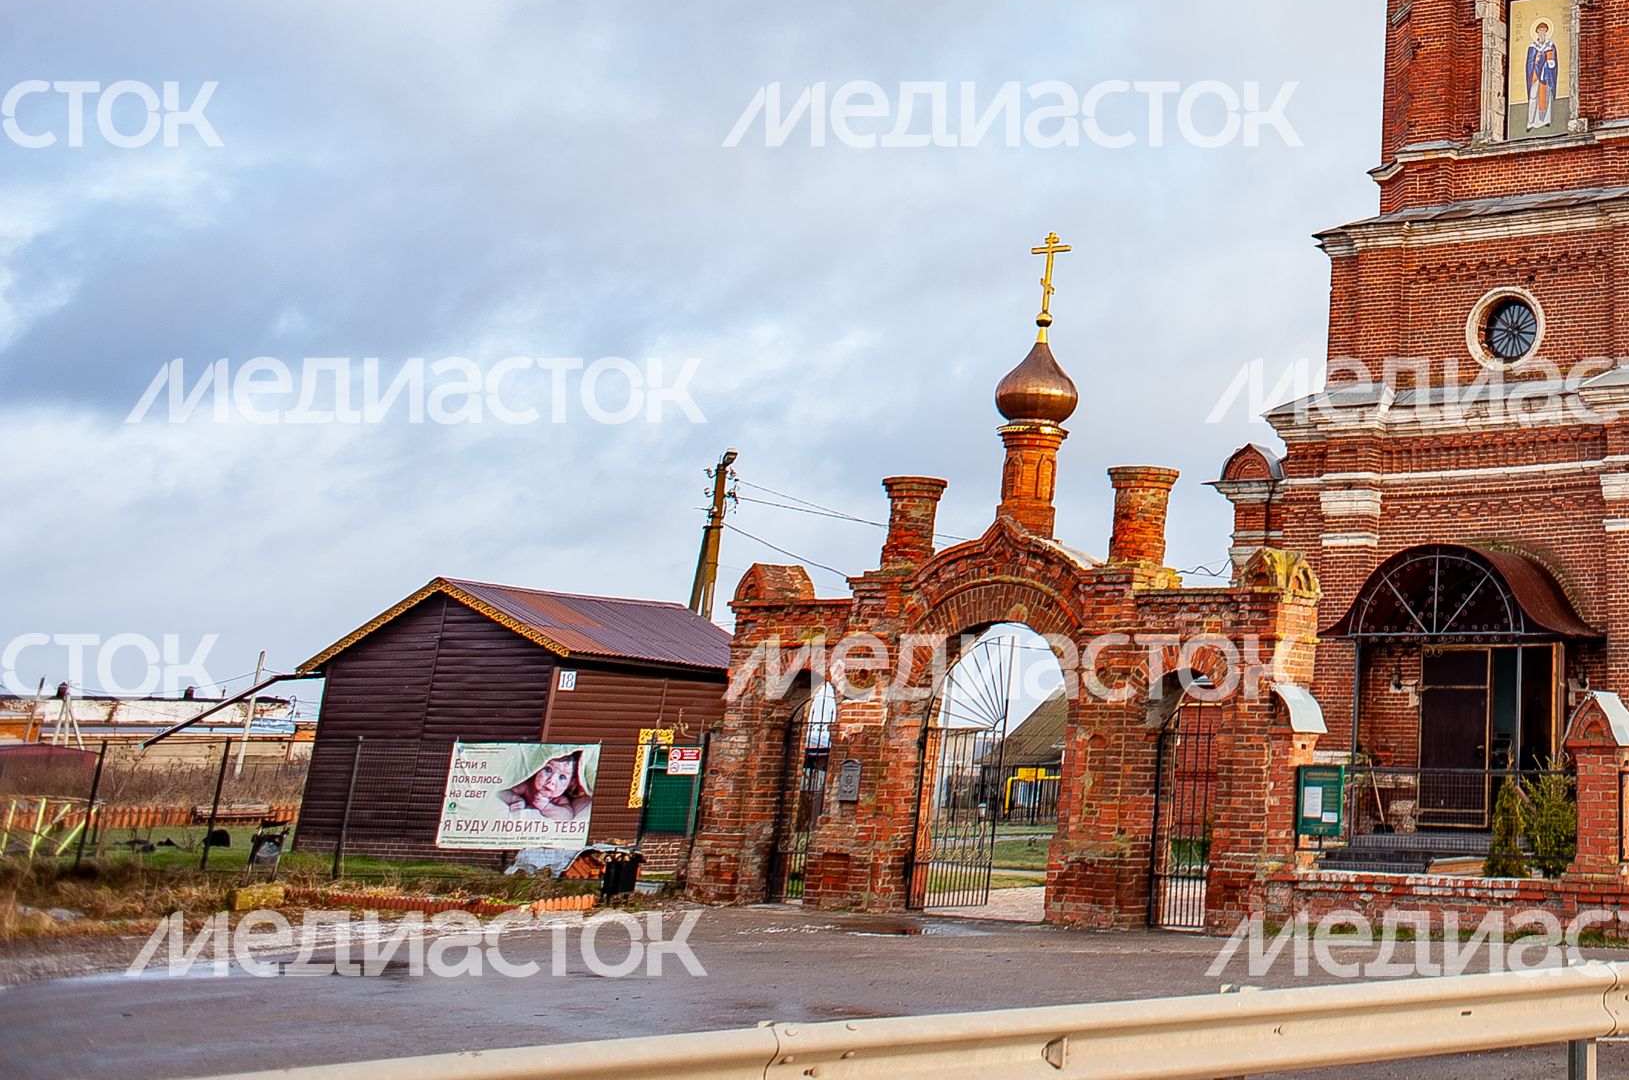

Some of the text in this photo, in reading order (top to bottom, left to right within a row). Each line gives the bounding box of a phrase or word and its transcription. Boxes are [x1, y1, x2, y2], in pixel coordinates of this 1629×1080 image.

[561, 672, 575, 689] 18
[454, 758, 478, 770] Если
[451, 774, 503, 785] появлюсь
[449, 789, 488, 799] на свет
[443, 820, 586, 835] Я БУДУ ЛЮБИТЬ ТЕБЯ
